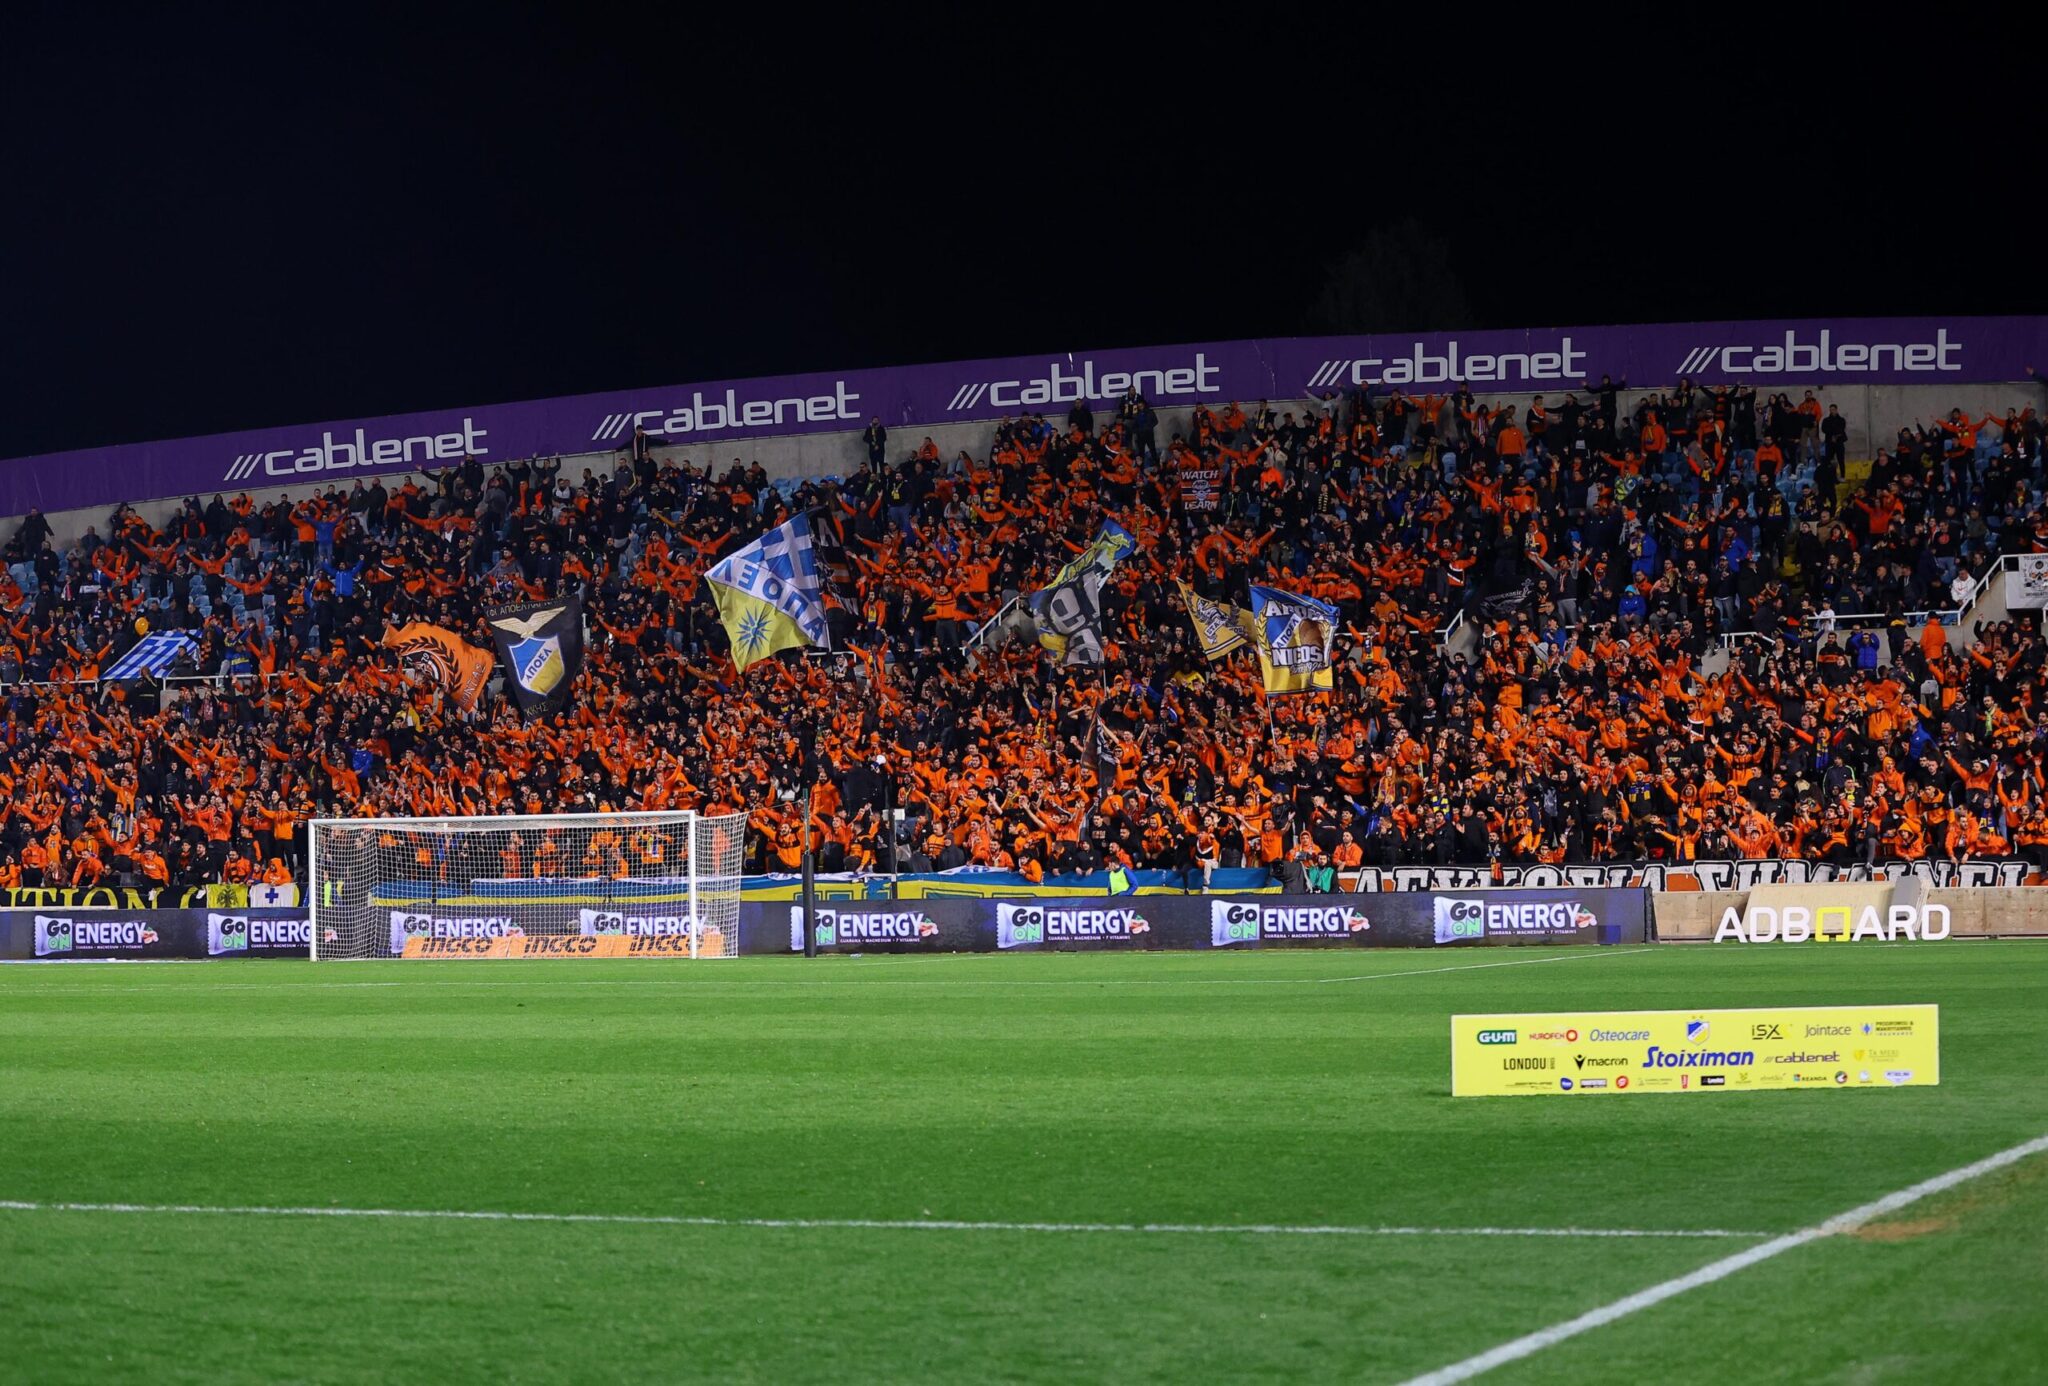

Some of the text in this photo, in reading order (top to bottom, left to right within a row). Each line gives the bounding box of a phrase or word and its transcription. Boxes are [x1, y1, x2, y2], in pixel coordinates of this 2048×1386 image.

[1351, 337, 1586, 385] cablenet
[1721, 329, 1962, 372] cablenet
[990, 353, 1220, 407] cablenet
[633, 381, 861, 436] cablenet
[265, 418, 489, 476] cablenet
[1181, 470, 1218, 480] WATCH
[1184, 500, 1218, 511] LEARN
[526, 648, 552, 682] ΑΠΟΕΛ
[840, 912, 924, 937] ENERGY
[1047, 910, 1135, 934] ENERGY
[1264, 907, 1354, 932] ENERGY
[1488, 903, 1581, 929] ENERGY
[75, 922, 146, 944] ENERGY
[251, 920, 310, 942] ENERG
[435, 918, 511, 937] ENERGY
[1589, 1029, 1650, 1041] Osteocare
[1805, 1024, 1852, 1038] Jointace
[1503, 1058, 1546, 1070] LONDOU
[1587, 1057, 1628, 1066] macron
[1642, 1046, 1754, 1068] Stoiximan
[1775, 1051, 1840, 1064] cablenet
